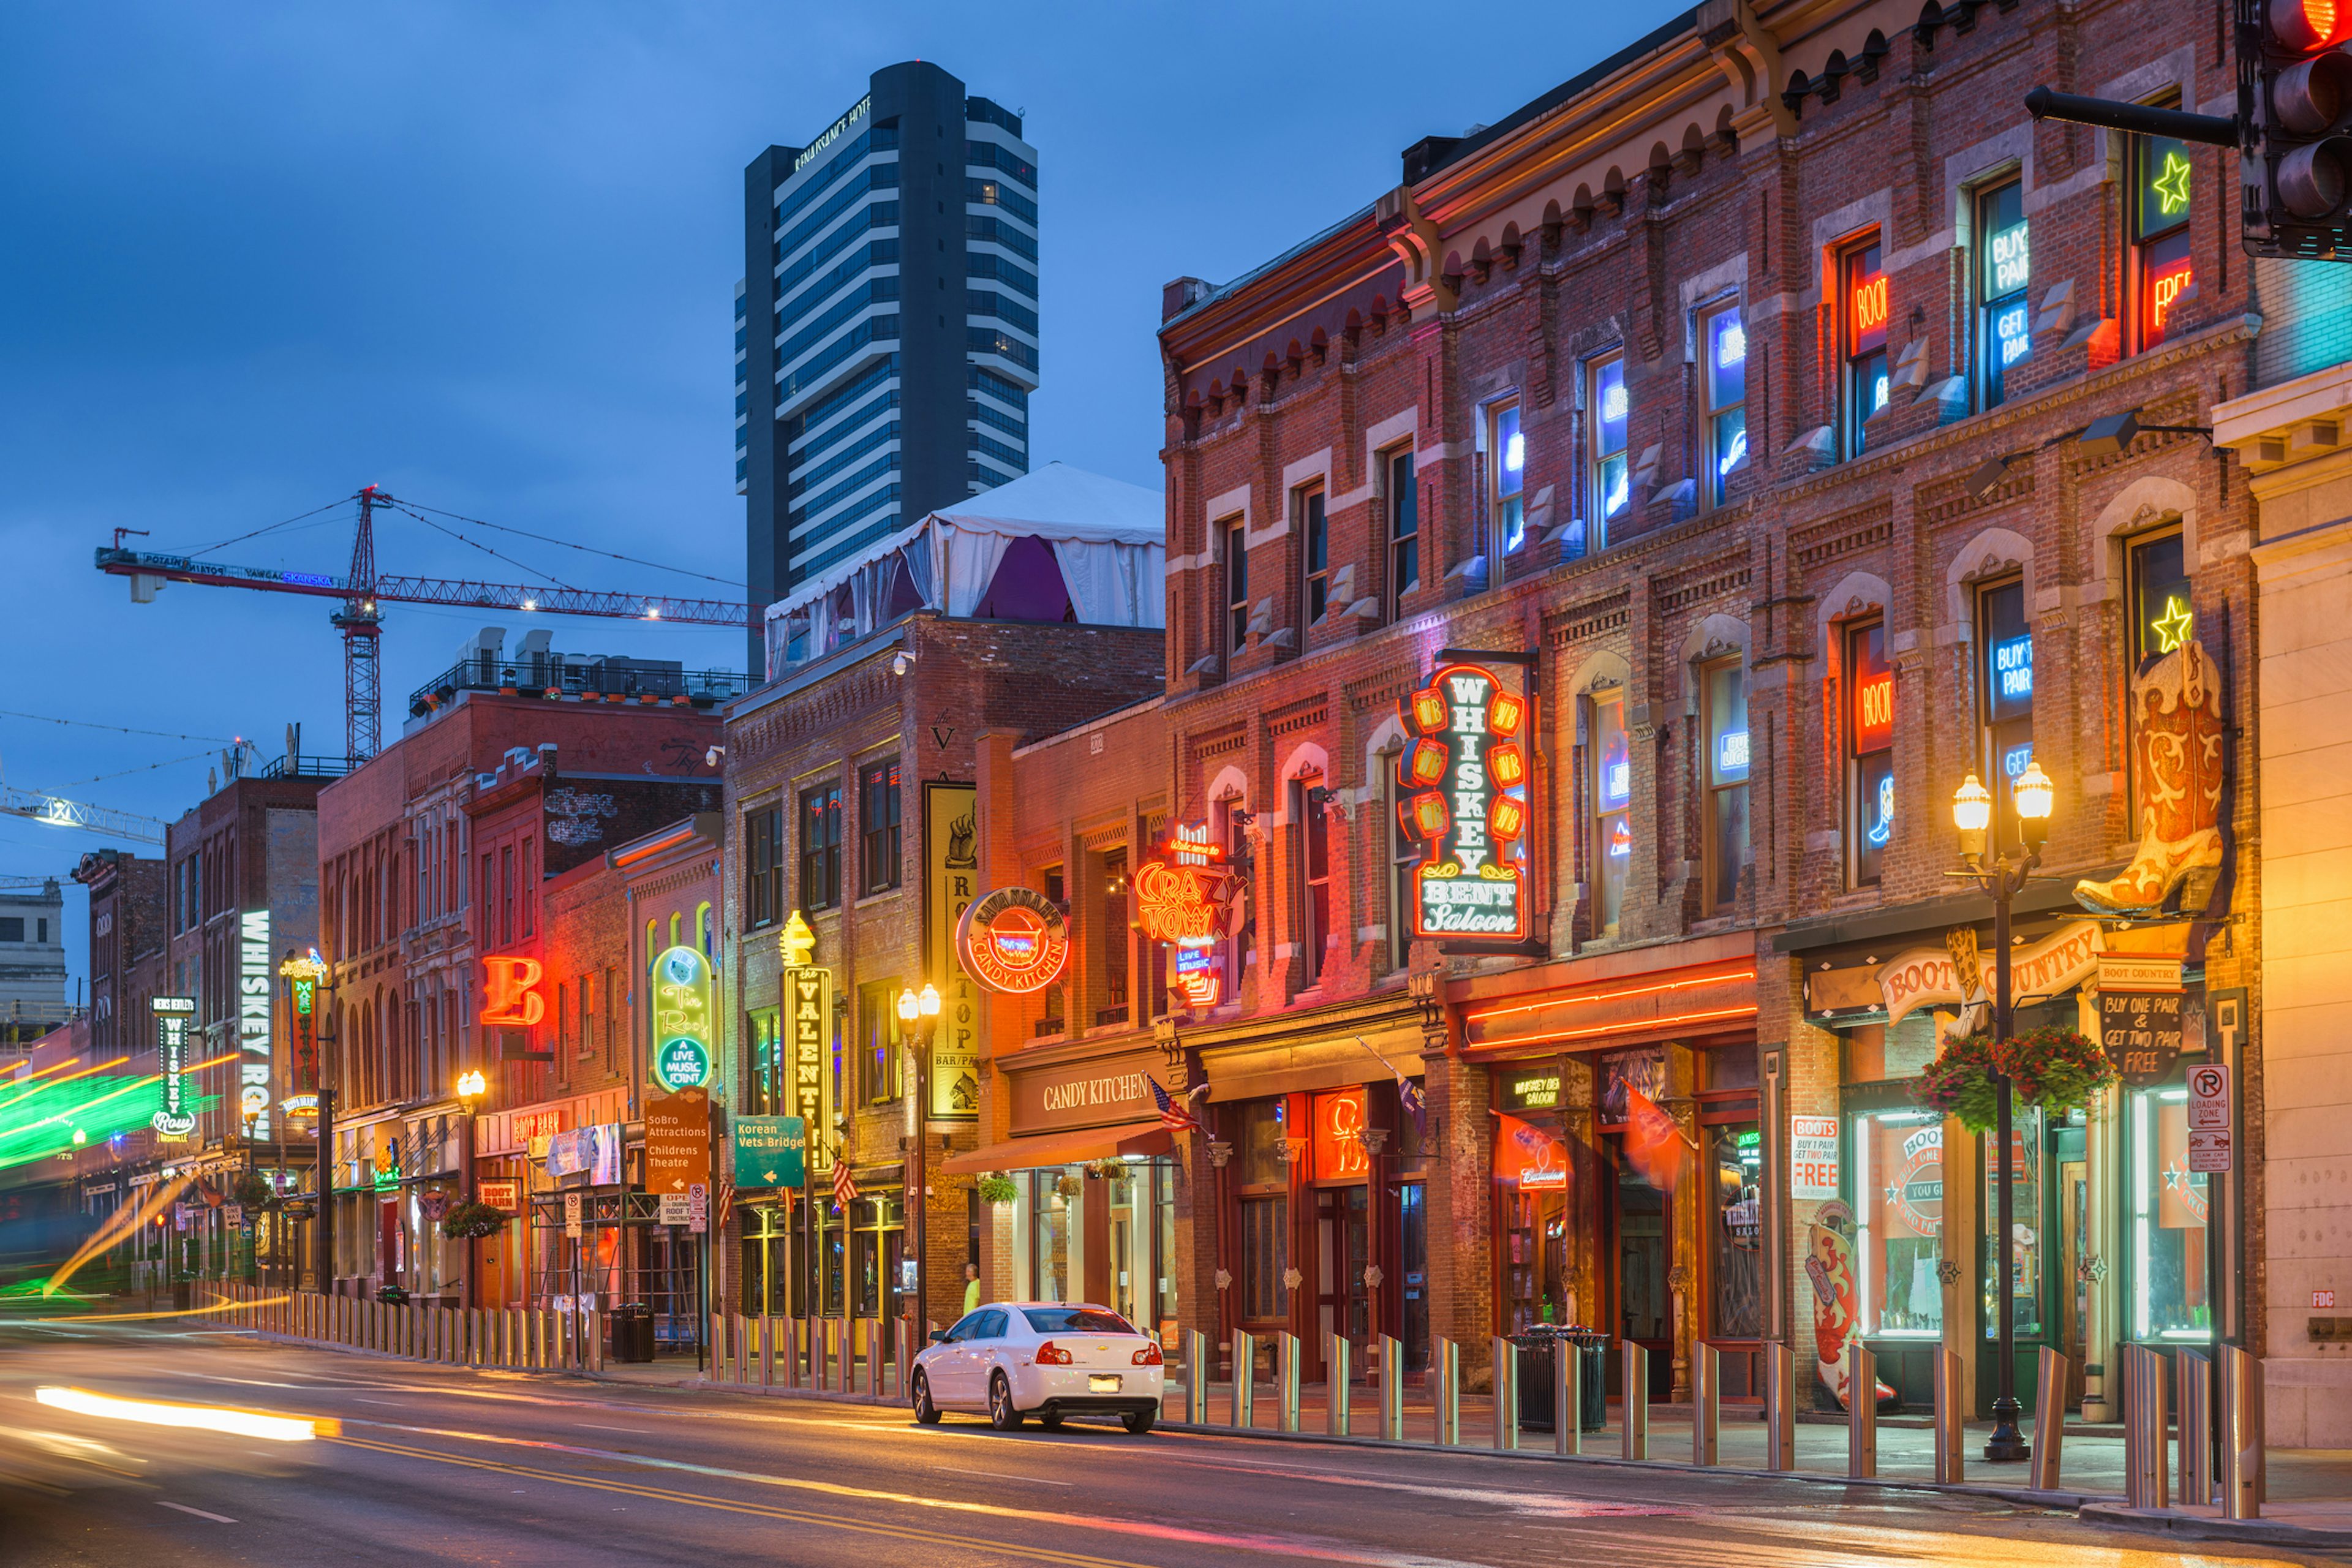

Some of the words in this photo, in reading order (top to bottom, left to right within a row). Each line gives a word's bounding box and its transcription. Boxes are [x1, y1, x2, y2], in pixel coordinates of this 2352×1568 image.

[794, 117, 846, 172] RENAISSANCE
[848, 95, 871, 126] HOTE
[1998, 309, 2024, 337] GET
[146, 555, 183, 567] POTAIN
[284, 571, 332, 586] SKANSKA
[1419, 697, 1442, 725] WB
[1495, 701, 1519, 729] WB
[1416, 749, 1442, 779] WB
[1498, 754, 1521, 782] WB
[1448, 676, 1488, 876] WHISKEY
[1419, 802, 1444, 831] WB
[1496, 804, 1519, 833] WB
[1170, 839, 1208, 854] Welcome
[1209, 843, 1219, 856] to
[1135, 862, 1249, 908] CRAZY
[1422, 880, 1517, 905] BENT
[1139, 904, 1234, 940] TOWN
[1423, 903, 1517, 933] Saloon
[1178, 949, 1200, 962] LIVE
[973, 943, 1012, 986] CANDY
[1015, 943, 1063, 988] KITCHEN
[1178, 957, 1210, 972] MUSIC
[241, 909, 270, 1055] WHISKEY
[1888, 959, 1956, 1004] BOOT
[2104, 968, 2129, 978] BOOT
[2132, 968, 2176, 979] COUNTRY
[661, 984, 703, 1009] Tin
[2105, 997, 2127, 1014] BUY
[2130, 997, 2150, 1014] ONE
[2153, 997, 2179, 1015] PAIR
[658, 1009, 709, 1039] Roof
[2134, 1014, 2148, 1028] &
[679, 1041, 688, 1049] A
[2105, 1029, 2127, 1047] GET
[2128, 1030, 2153, 1047] TWO
[2155, 1030, 2182, 1048] PAIR
[673, 1051, 695, 1061] LIVE
[2123, 1051, 2159, 1073] FREE
[165, 1018, 183, 1114] WHISKEY
[666, 1062, 702, 1072] MUSIC
[669, 1073, 700, 1084] JOINT
[1044, 1080, 1087, 1111] CANDY
[1090, 1072, 1148, 1106] KITCHEN
[1526, 1091, 1555, 1106] SALOON
[241, 1063, 270, 1142] ROW
[2192, 1100, 2226, 1109] LOADING
[157, 1111, 192, 1132] Row
[648, 1115, 679, 1125] SoBro
[2198, 1109, 2220, 1118] ZONE
[649, 1127, 706, 1137] Attractions
[738, 1124, 777, 1134] Korean
[1796, 1120, 1835, 1136] BOOTS
[649, 1145, 698, 1156] Childrens
[739, 1137, 763, 1147] Vets
[767, 1137, 803, 1150] Bridge
[1797, 1140, 1812, 1149] BUY
[1817, 1140, 1834, 1150] PAIR
[1905, 1130, 1942, 1158] BOO
[649, 1158, 689, 1167] Theatre
[1793, 1150, 1806, 1159] GET
[1806, 1150, 1823, 1159] TWO
[1822, 1151, 1838, 1160] PAIR
[1919, 1149, 1939, 1163] ONE
[1794, 1163, 1838, 1187] FREE
[484, 1188, 512, 1197] BOOT
[1912, 1185, 1931, 1197] YOU
[484, 1197, 513, 1207] BARN
[1901, 1200, 1918, 1227] TWO
[2312, 1291, 2334, 1307] FDC
